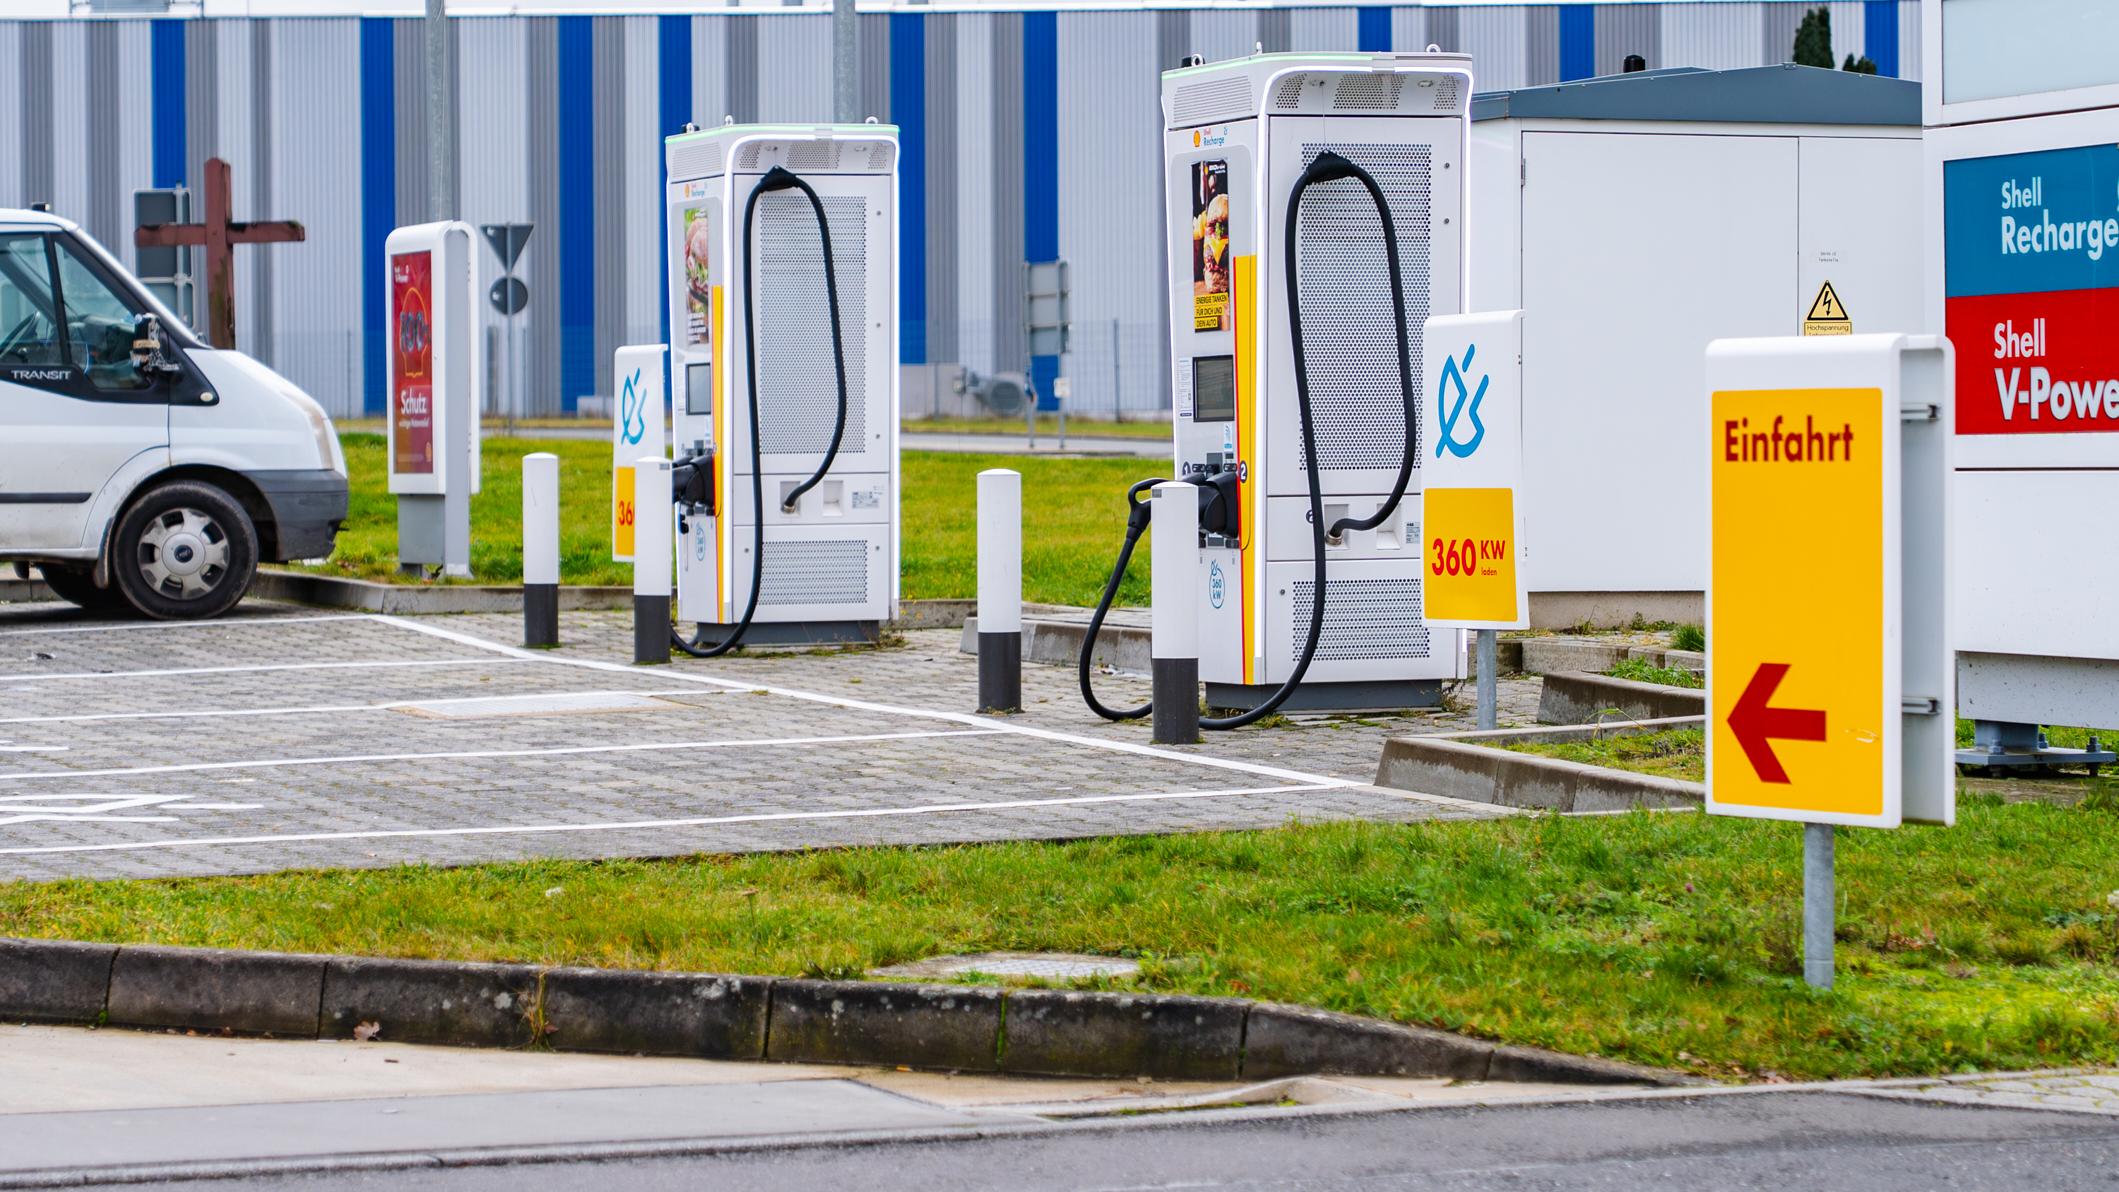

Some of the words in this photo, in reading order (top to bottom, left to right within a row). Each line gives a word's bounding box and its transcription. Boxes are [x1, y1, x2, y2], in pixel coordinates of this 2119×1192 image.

[2001, 176, 2042, 210] Shell
[2001, 208, 2119, 261] Recharge
[1195, 296, 1212, 305] ENERGIE
[1212, 295, 1228, 303] TANKEN
[1206, 318, 1217, 327] AUTO
[1806, 324, 1849, 332] Hochspannung
[1994, 317, 2046, 359] Shell
[11, 370, 72, 380] TRANSIT
[400, 388, 428, 416] Schutz
[1725, 414, 1854, 462] Einfahrt
[618, 500, 635, 526] 36
[1431, 538, 1477, 577] 360
[1480, 540, 1506, 560] KW
[1480, 567, 1498, 576] laden
[1212, 578, 1222, 589] 360
[1212, 589, 1222, 600] kW
